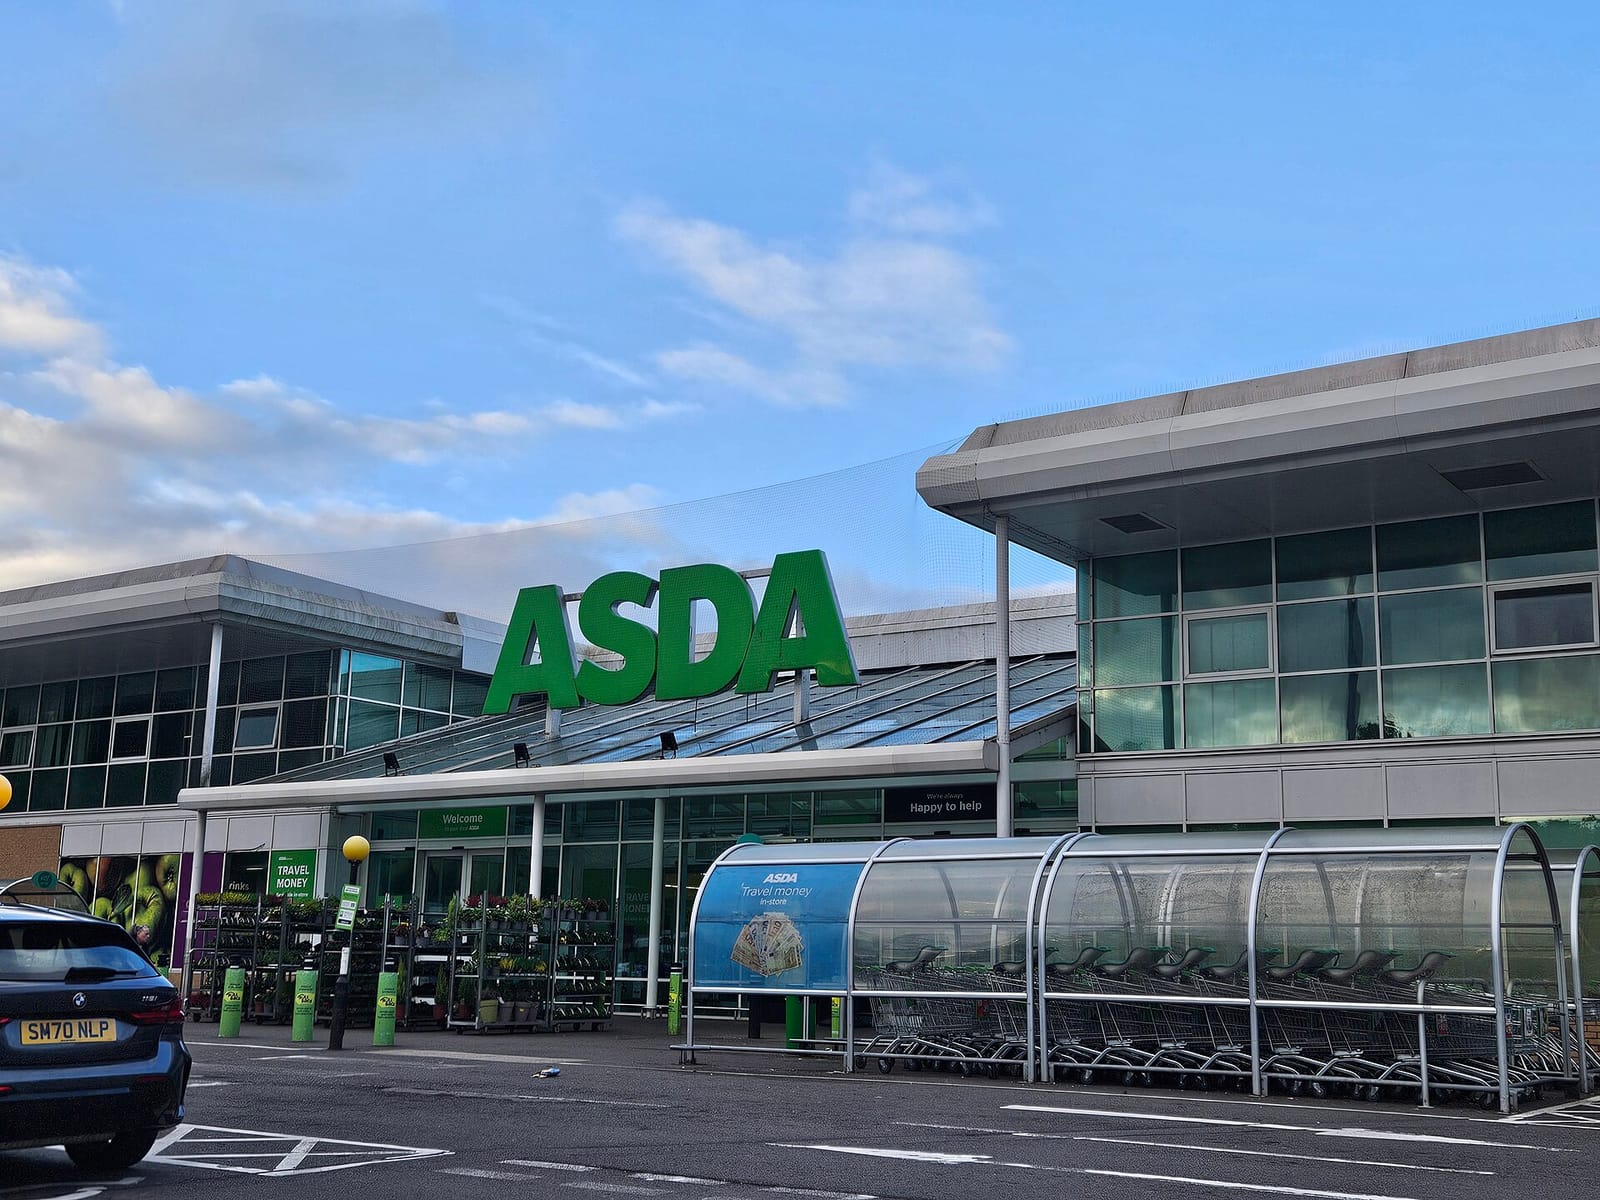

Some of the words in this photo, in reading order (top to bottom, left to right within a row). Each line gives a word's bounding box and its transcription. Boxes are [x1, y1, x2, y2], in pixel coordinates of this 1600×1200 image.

[481, 548, 862, 716] ASDA
[910, 802, 943, 814] Happy
[945, 801, 956, 811] to
[959, 800, 982, 812] help
[442, 814, 483, 824] Welcome
[277, 865, 309, 876] TRAVEL
[276, 878, 308, 889] MONEY
[763, 872, 798, 884] ASDA
[227, 881, 250, 891] rinks
[742, 886, 773, 897] Travel
[774, 887, 813, 898] money
[28, 1021, 73, 1040] SM70
[78, 1020, 109, 1038] NLP
